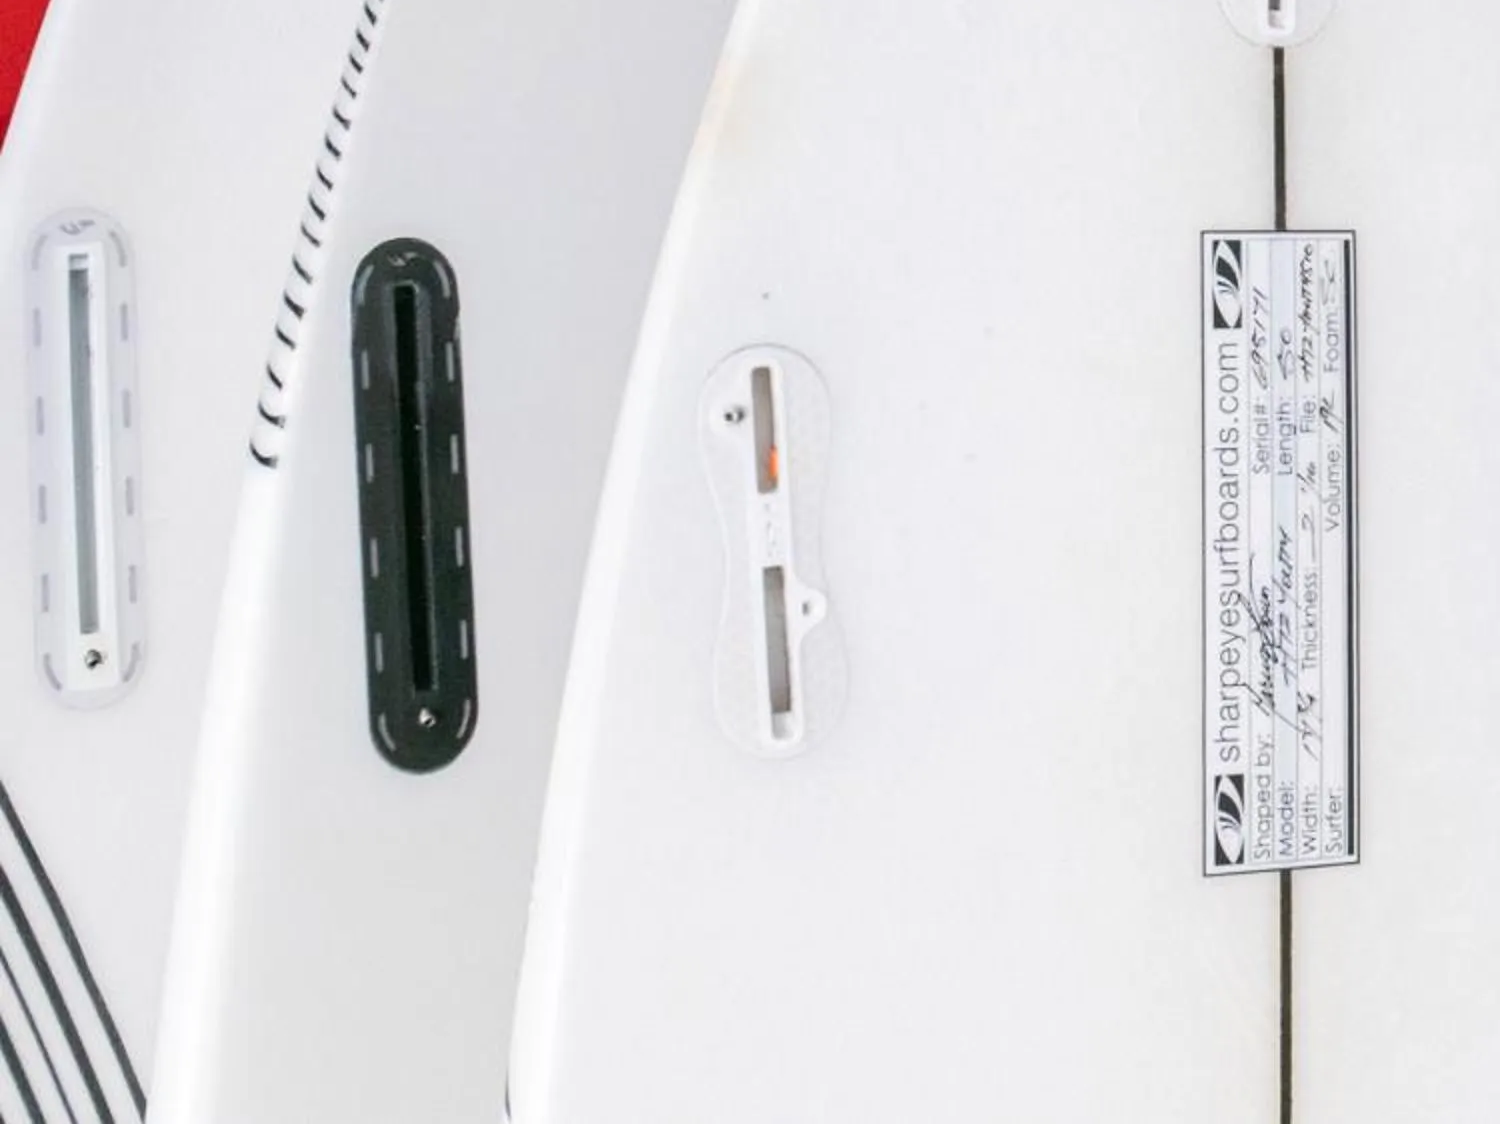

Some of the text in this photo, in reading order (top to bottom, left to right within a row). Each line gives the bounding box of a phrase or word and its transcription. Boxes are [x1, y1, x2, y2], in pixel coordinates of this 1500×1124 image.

[1278, 395, 1298, 477] Length:
[1300, 394, 1317, 434] File:
[1320, 443, 1342, 533] Volume:
[1212, 342, 1247, 764] sharpeyesurfboards.com
[1301, 564, 1320, 671] Thickness:
[1253, 733, 1276, 768] by:
[1253, 775, 1276, 860] Shaped
[1277, 780, 1295, 857] Model:
[1300, 785, 1320, 856] Width:
